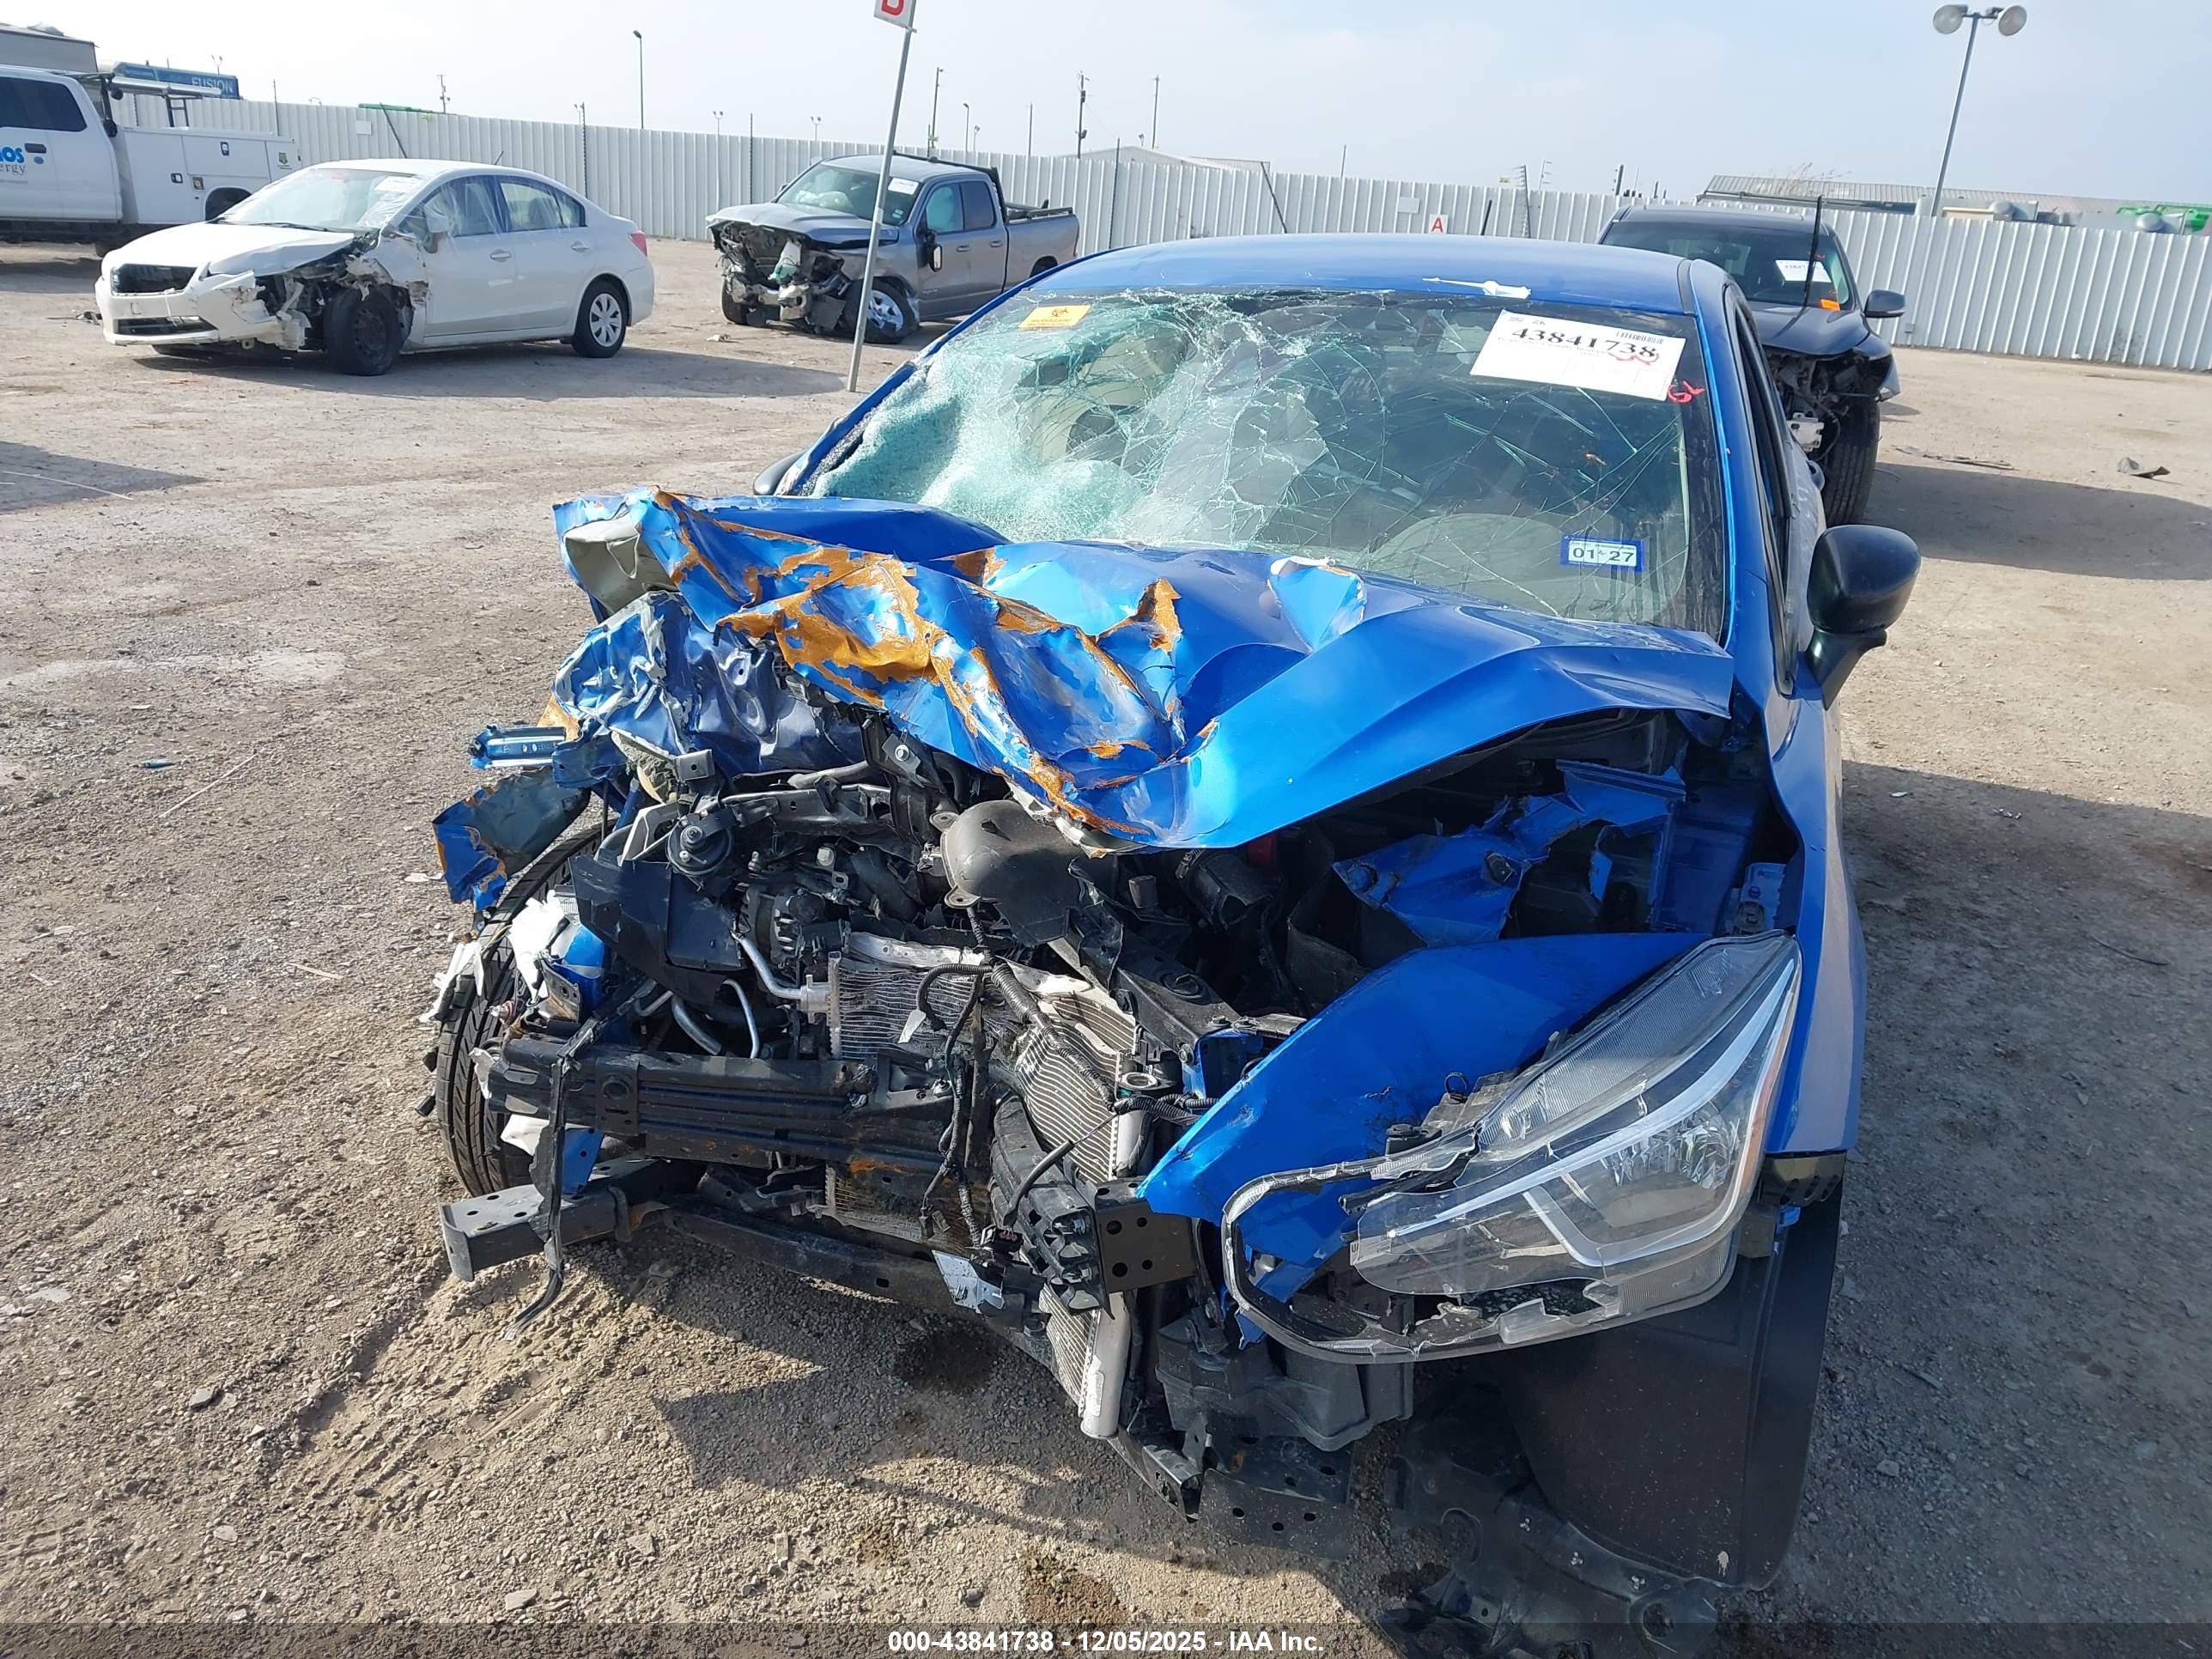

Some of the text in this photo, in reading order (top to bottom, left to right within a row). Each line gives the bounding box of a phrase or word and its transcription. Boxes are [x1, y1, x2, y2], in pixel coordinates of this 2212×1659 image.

[1431, 217, 1443, 233] A
[1511, 327, 1657, 359] 43841738
[1572, 547, 1635, 563] 01 27
